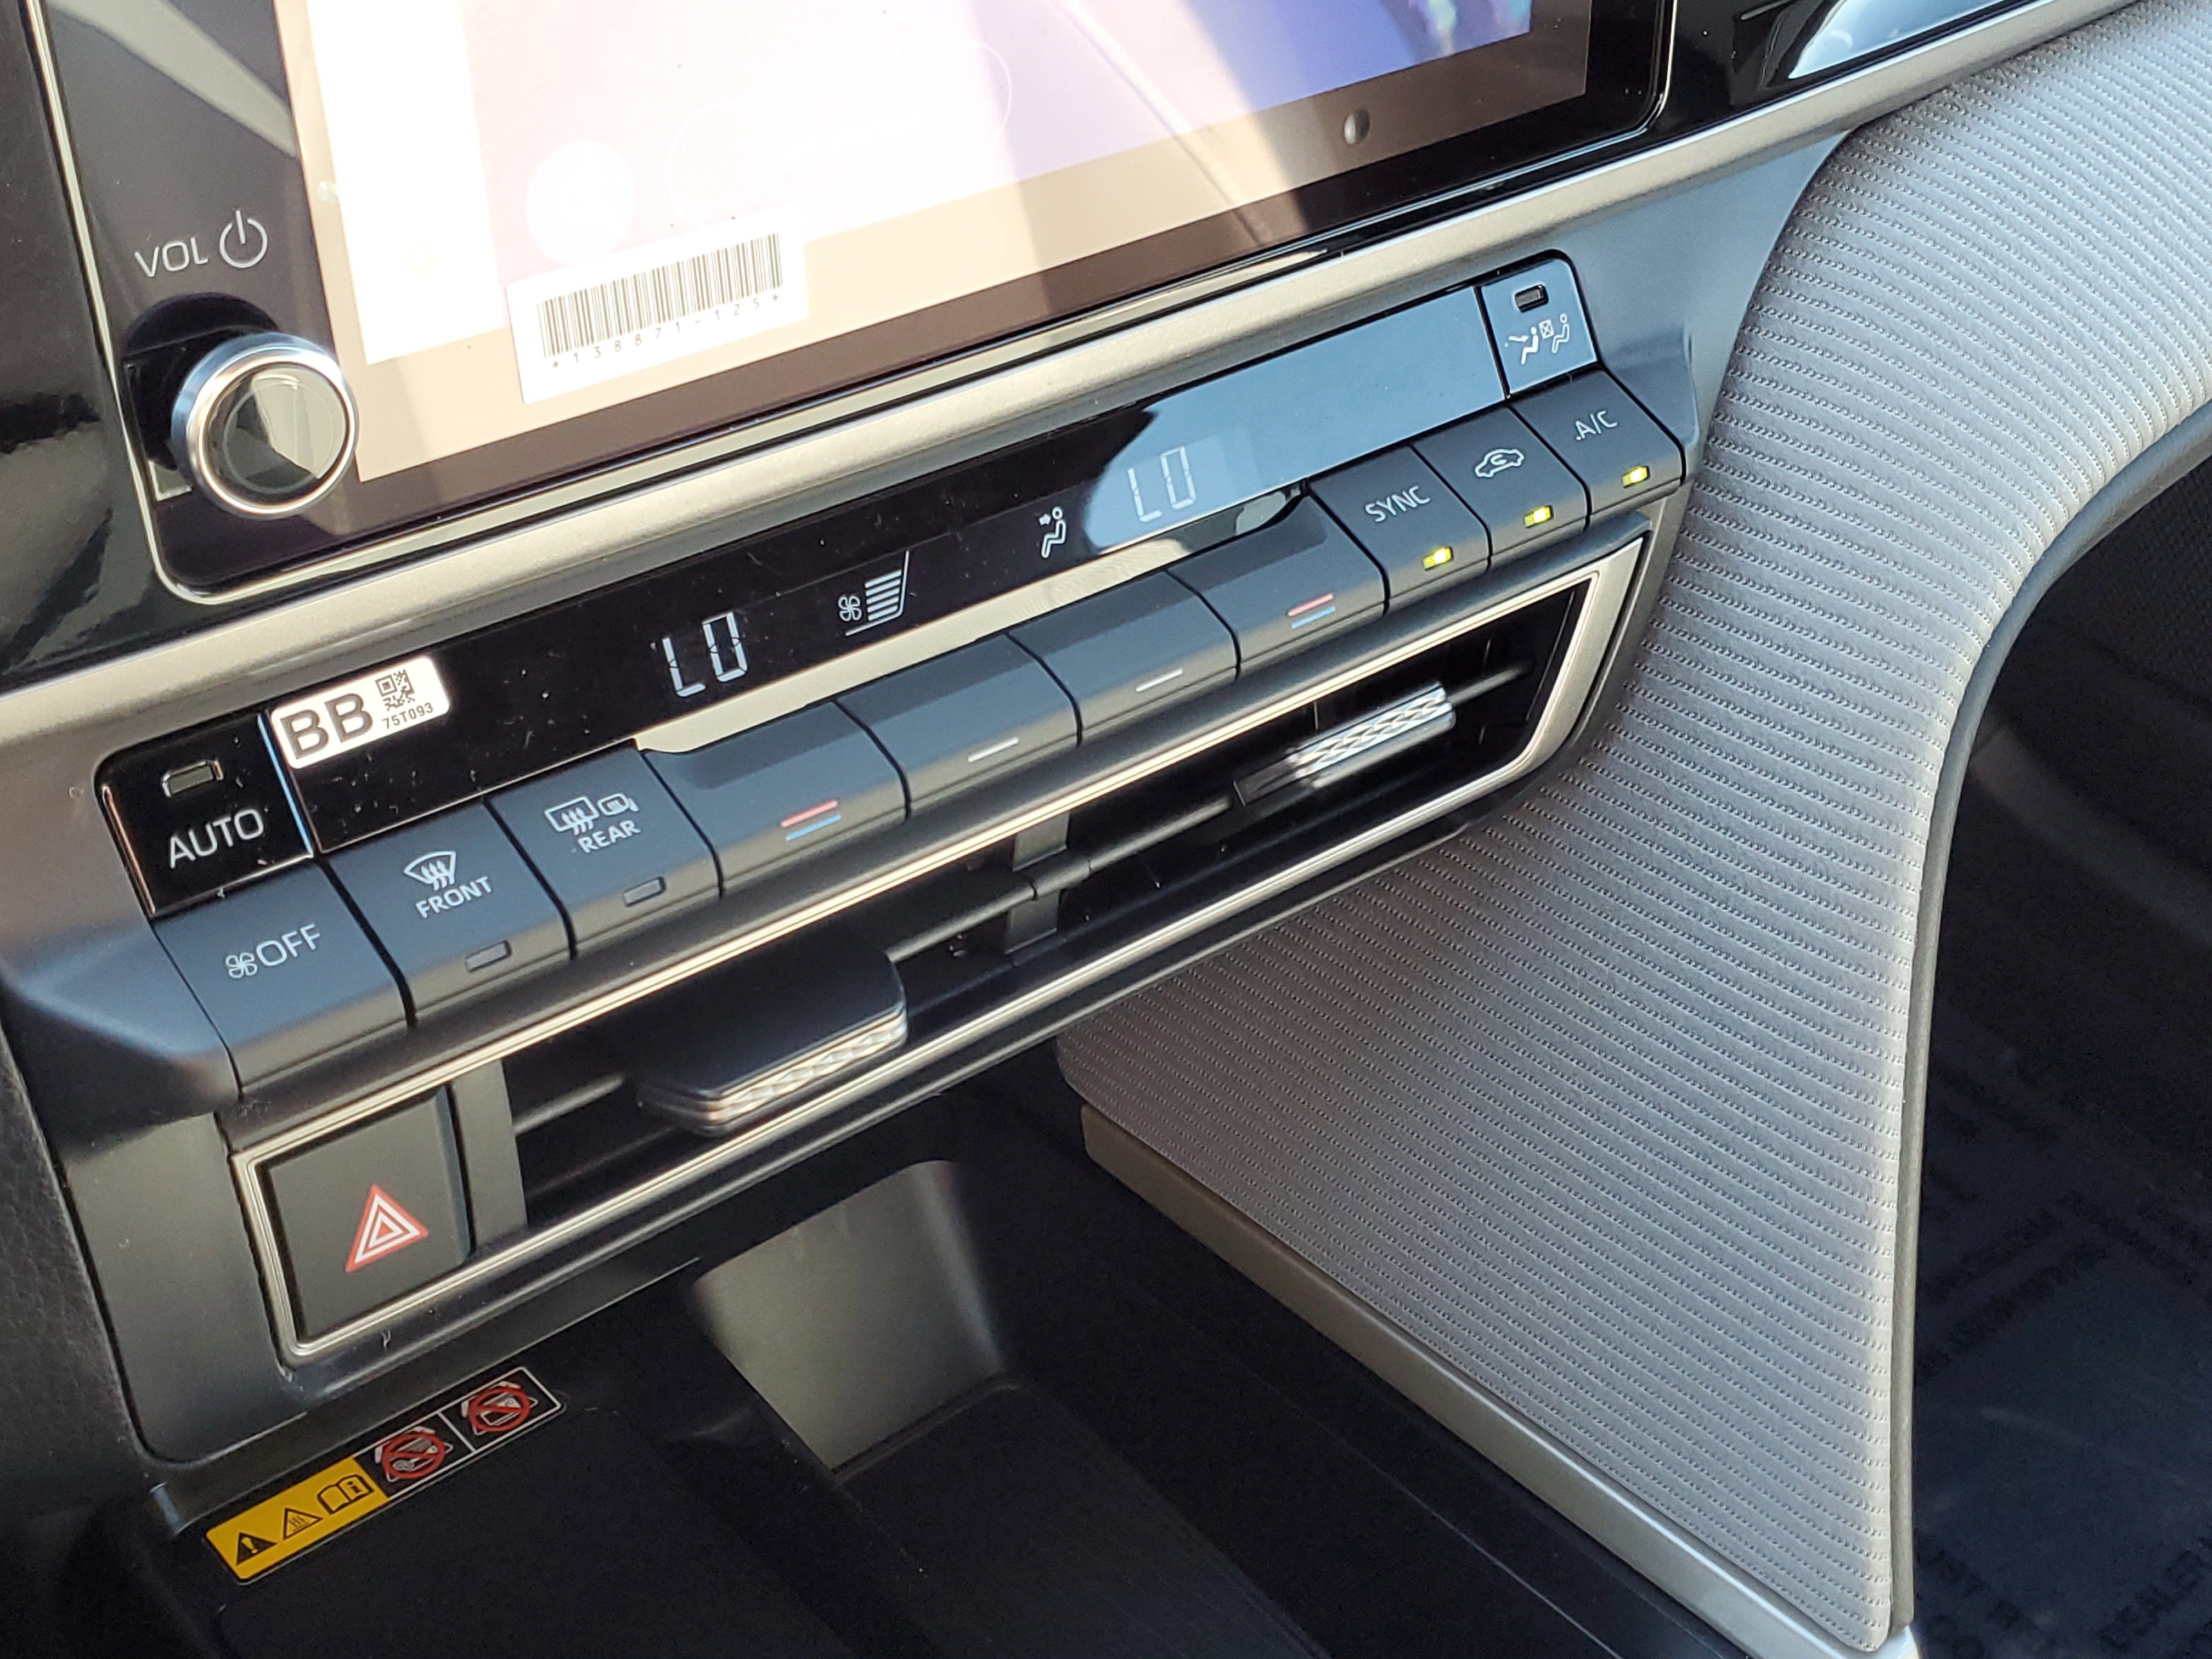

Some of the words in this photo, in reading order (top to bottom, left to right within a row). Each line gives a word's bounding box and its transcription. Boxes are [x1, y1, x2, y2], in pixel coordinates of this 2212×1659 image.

[134, 237, 208, 278] VOL
[1575, 410, 1618, 439] A/C
[1127, 447, 1196, 522] LO
[1365, 486, 1431, 523] SYNC
[662, 612, 747, 697] LO
[279, 693, 374, 760] BB
[381, 702, 434, 730] 75T093
[168, 808, 264, 869] AUTO
[578, 820, 641, 854] REAR
[415, 876, 493, 919] FRONT
[256, 922, 321, 968] OFF
